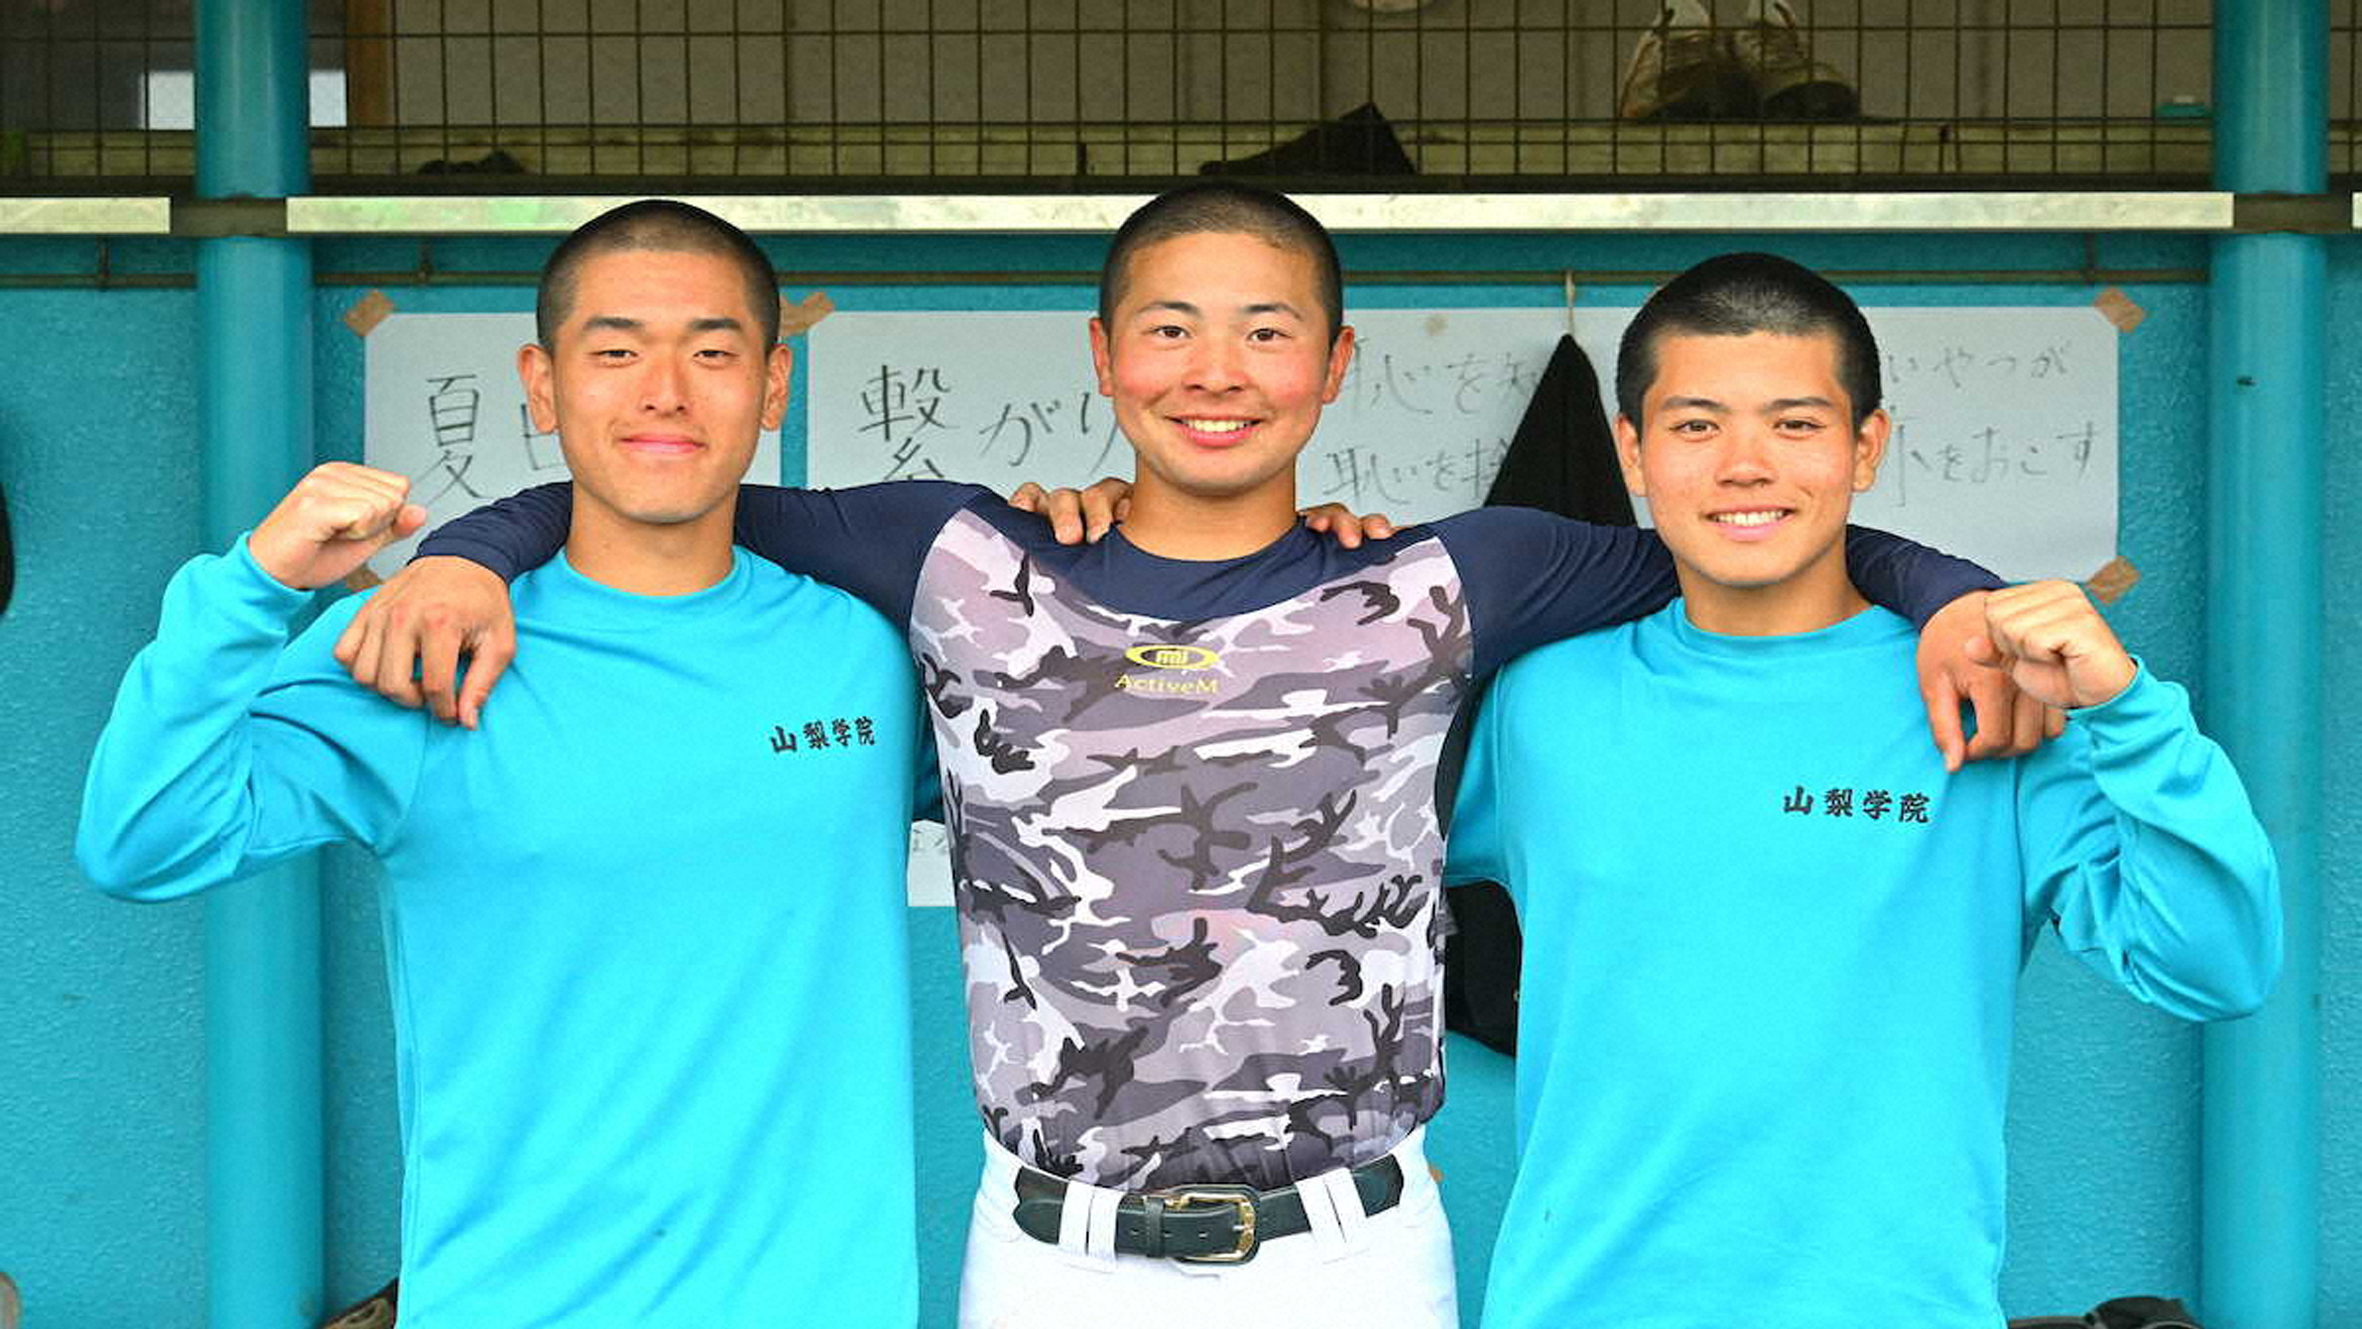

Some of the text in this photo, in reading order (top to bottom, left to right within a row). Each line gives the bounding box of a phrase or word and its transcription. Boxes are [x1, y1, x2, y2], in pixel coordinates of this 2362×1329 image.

[1115, 674, 1218, 693] ActiveM
[770, 716, 875, 753] 山梨学院
[1783, 785, 1930, 823] 山梨学院
